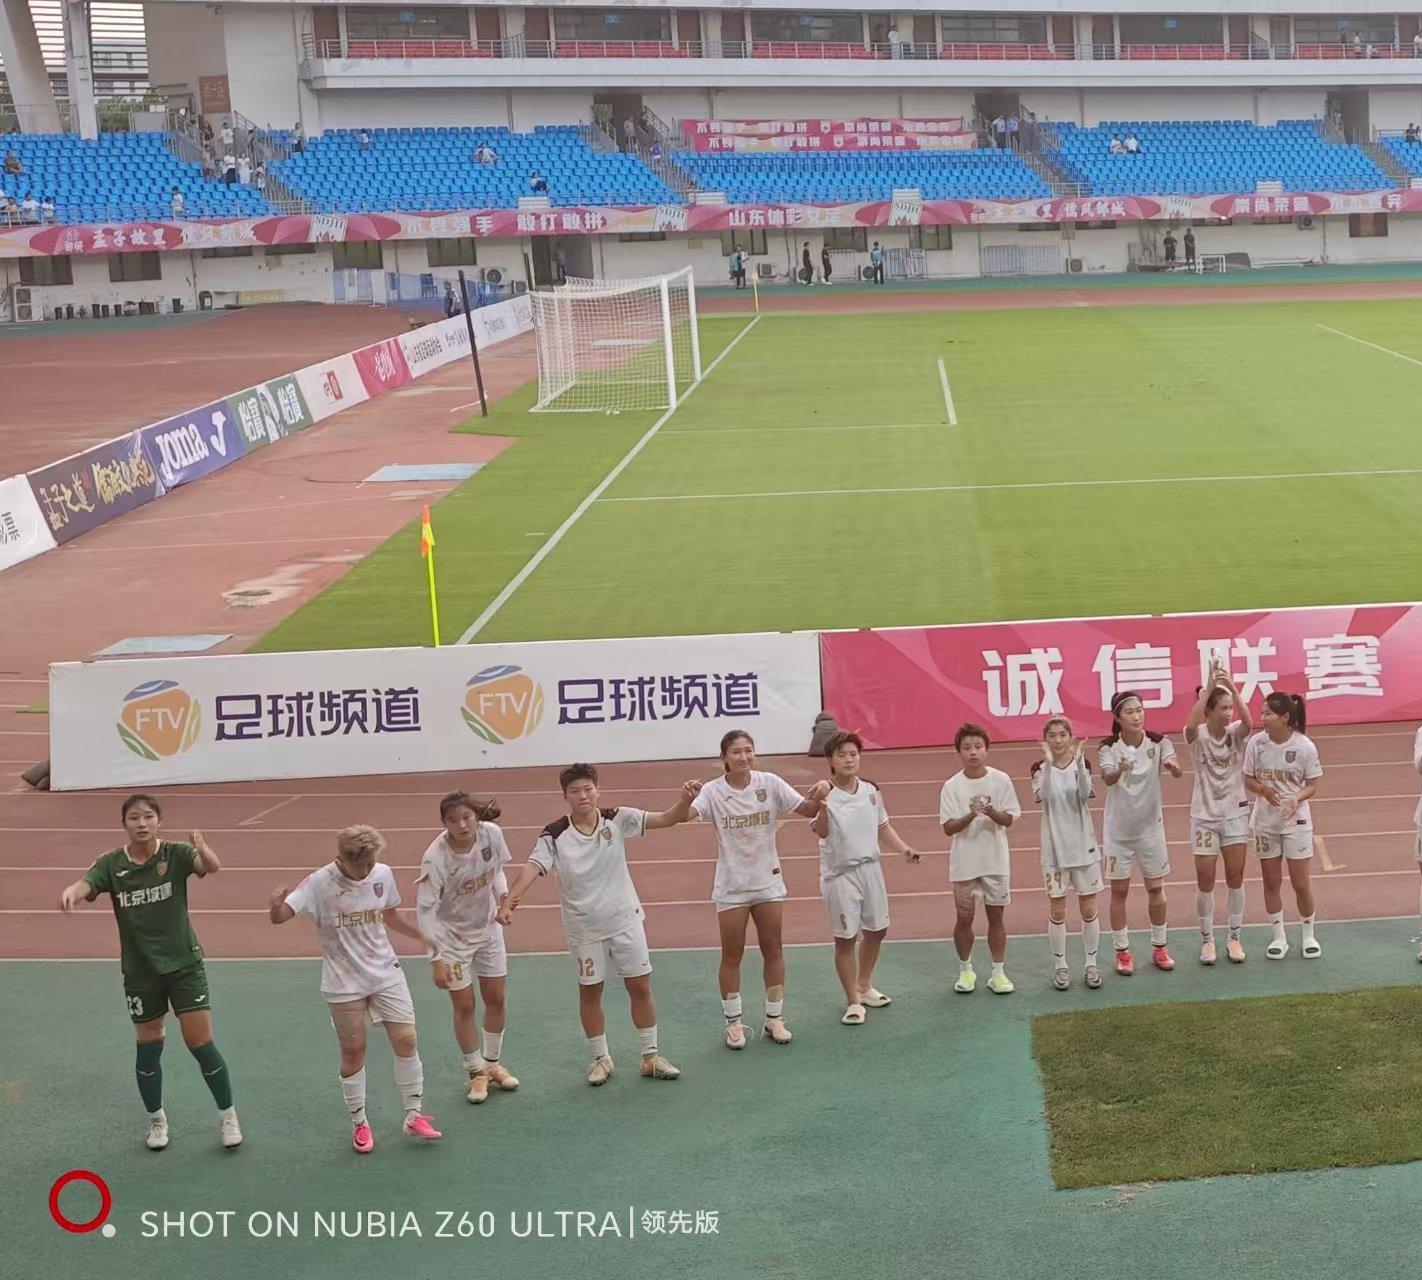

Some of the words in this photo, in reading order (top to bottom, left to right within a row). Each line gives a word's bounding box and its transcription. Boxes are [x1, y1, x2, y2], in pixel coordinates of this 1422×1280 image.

[981, 632, 1384, 717] 诚信联赛
[479, 692, 526, 717] FTV
[557, 672, 762, 725] 足球频道
[135, 707, 184, 734] FTV
[214, 687, 422, 741] 足球频道
[1195, 830, 1212, 848] 22
[116, 881, 173, 908] 北京城建
[577, 957, 595, 977] 12
